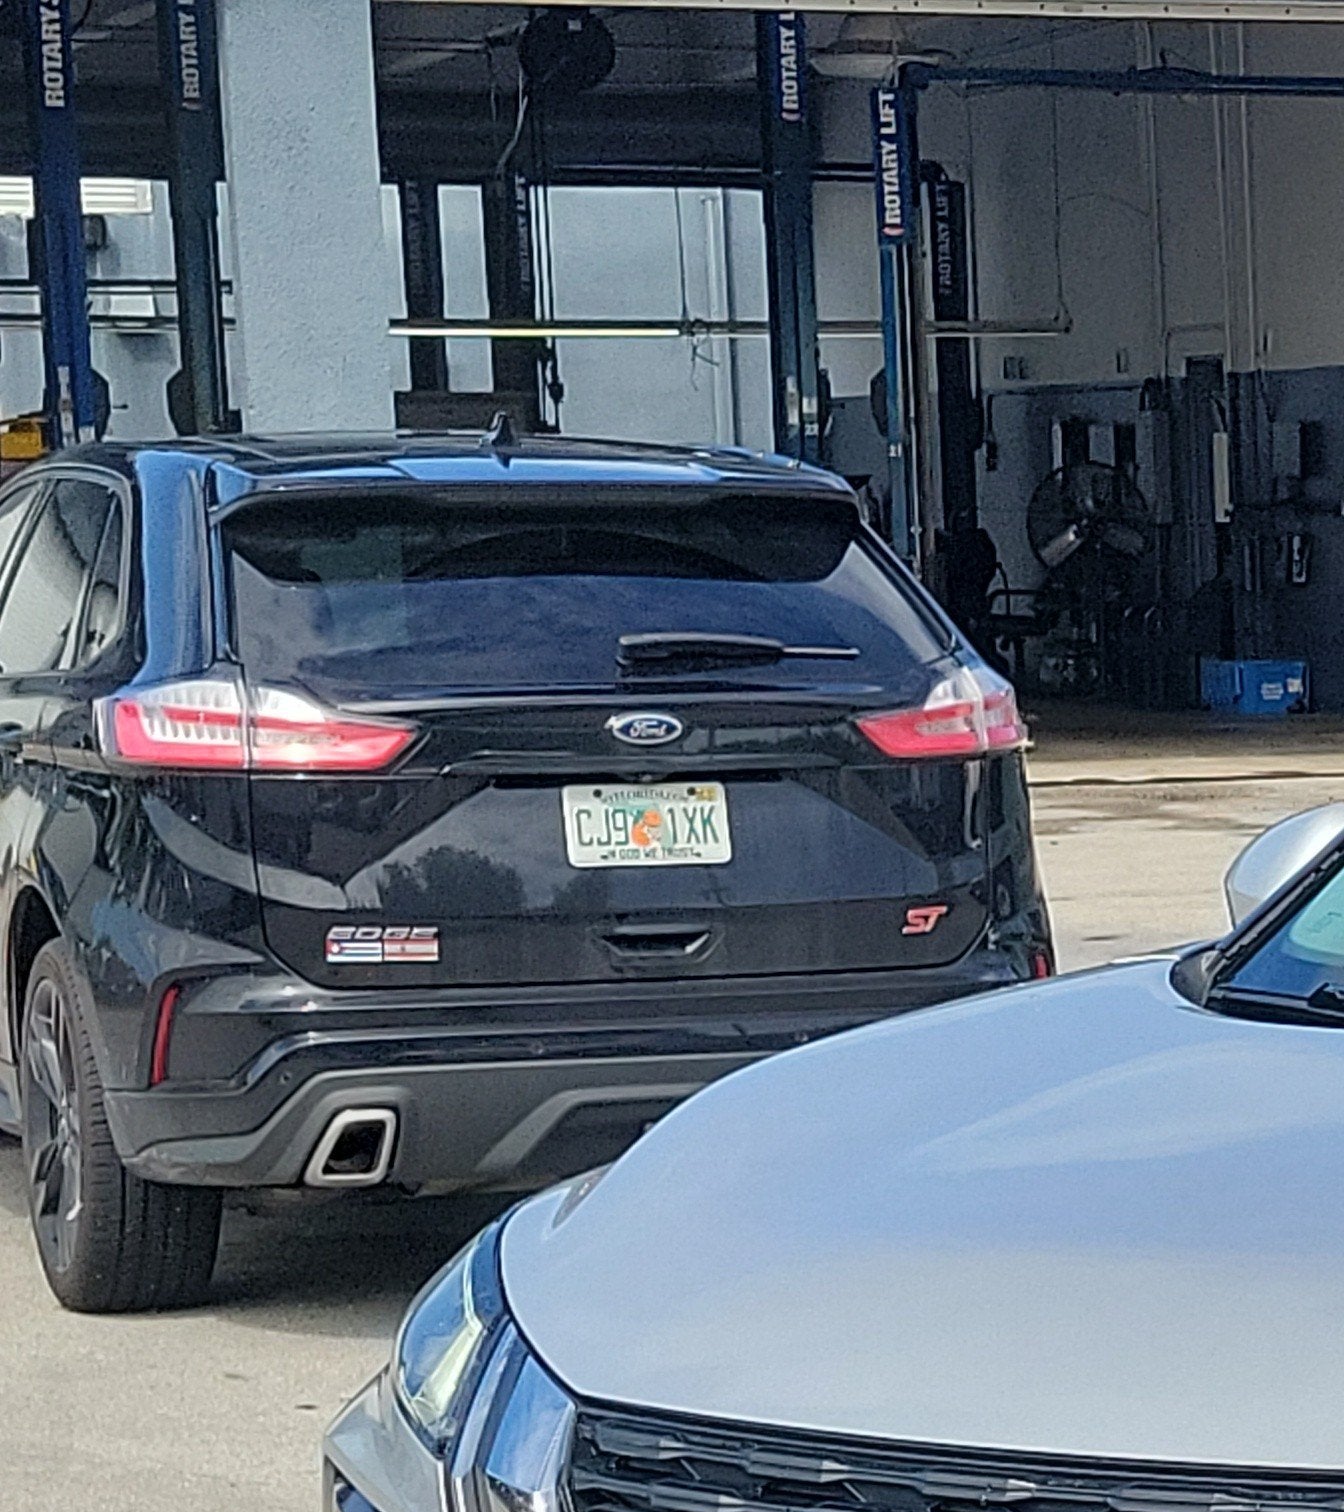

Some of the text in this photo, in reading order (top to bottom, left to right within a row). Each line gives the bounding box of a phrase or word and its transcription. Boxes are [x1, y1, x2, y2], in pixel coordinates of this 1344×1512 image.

[39, 5, 65, 107] ROTARY
[178, 11, 201, 98] ROTARY
[779, 25, 799, 110] ROTARY
[878, 90, 901, 224] ROTARY LIFT
[629, 720, 668, 738] Ford
[326, 926, 439, 940] EDGE
[902, 905, 948, 935] ST
